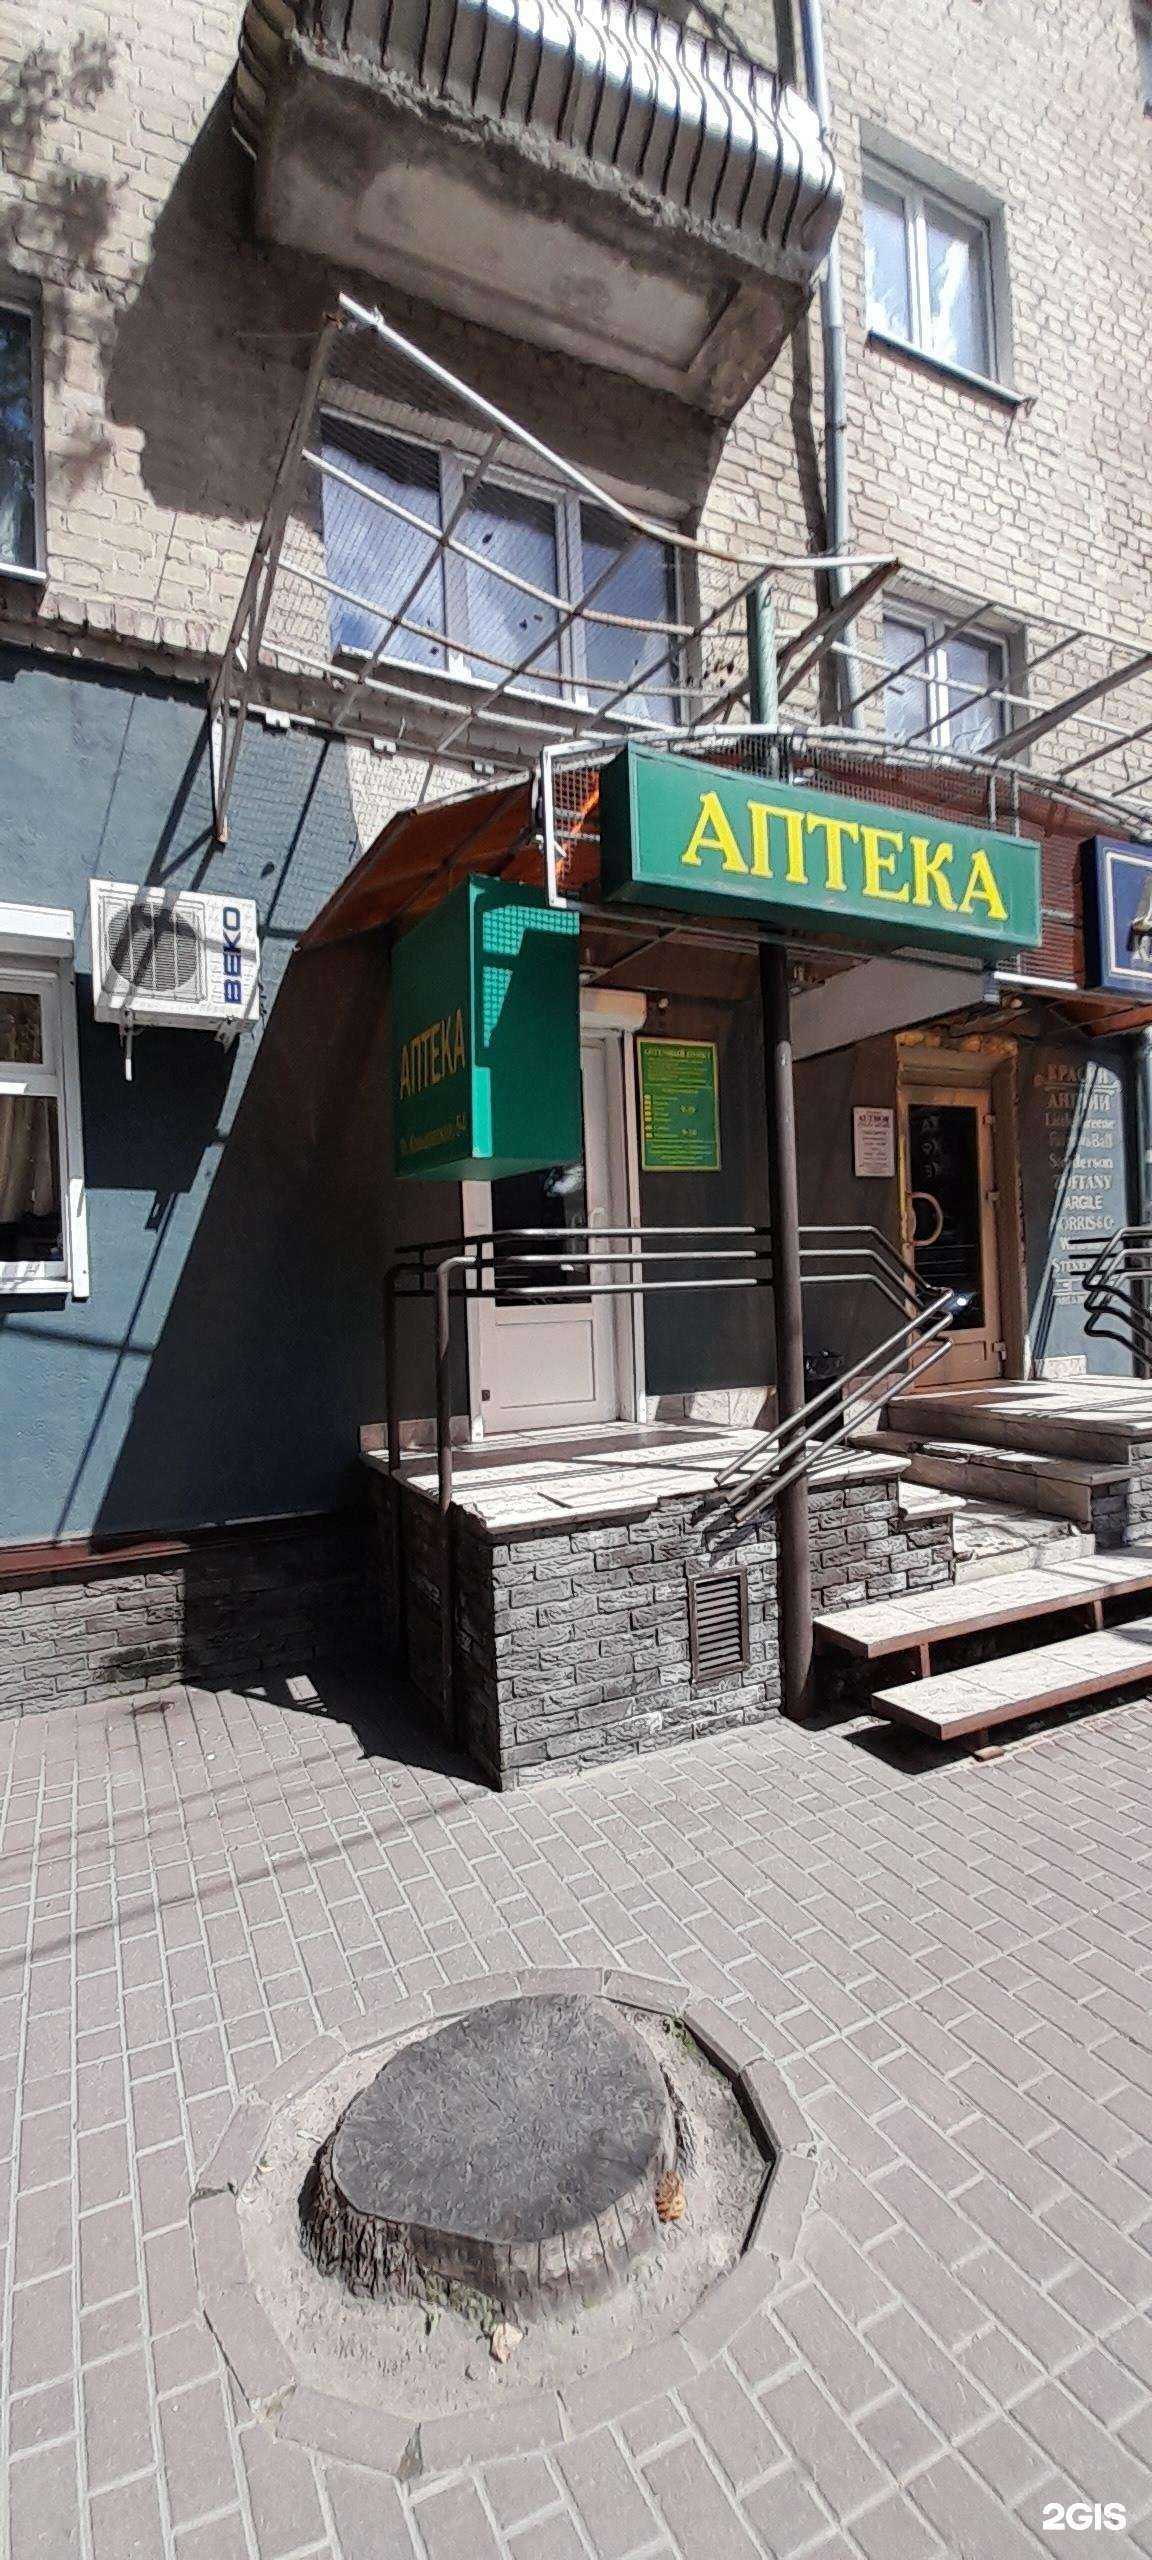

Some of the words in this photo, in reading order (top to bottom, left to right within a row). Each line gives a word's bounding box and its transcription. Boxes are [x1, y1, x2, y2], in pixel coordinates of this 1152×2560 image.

[681, 791, 1008, 921] АПТЕКА
[223, 906, 241, 1004] BEKO
[400, 1008, 466, 1101] АПТЕКА
